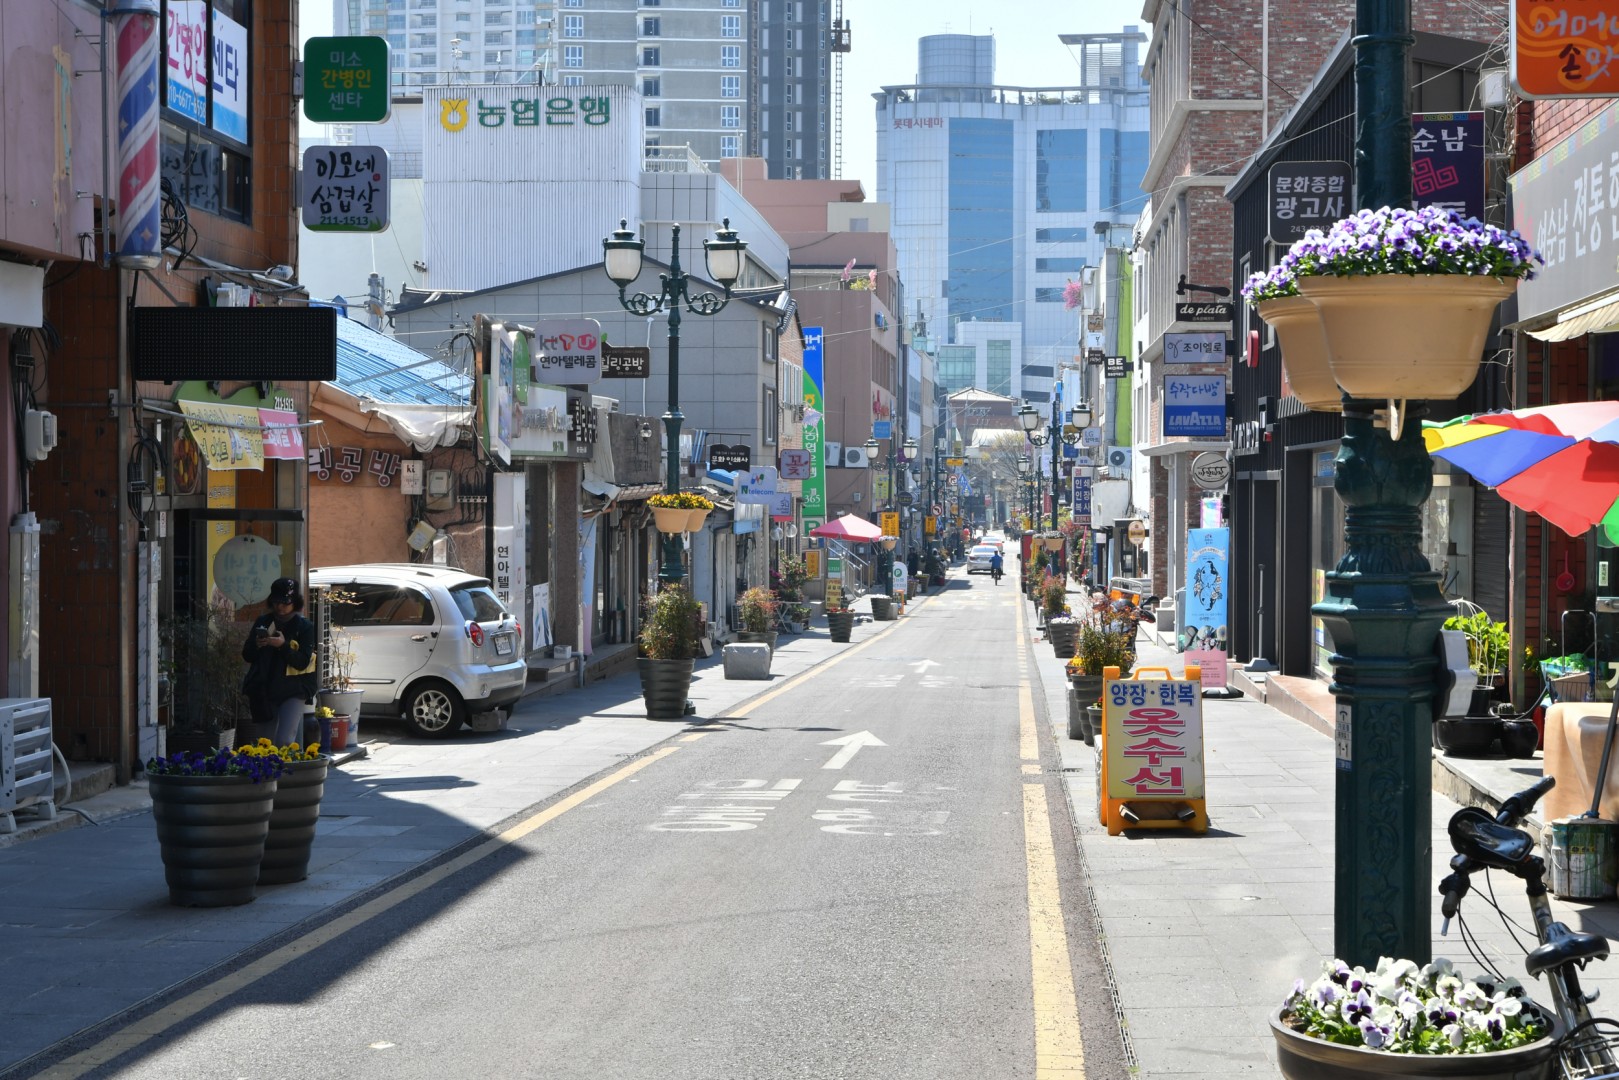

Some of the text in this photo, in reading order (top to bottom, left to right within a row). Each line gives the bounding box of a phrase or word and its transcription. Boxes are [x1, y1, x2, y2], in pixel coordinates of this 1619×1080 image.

[329, 51, 362, 65] 미소
[1558, 43, 1619, 81] 손맛
[320, 69, 372, 89] 간병인
[328, 91, 364, 110] 센타
[477, 96, 611, 128] 농협은행
[893, 117, 945, 129] 롯데시네마
[315, 151, 376, 179] 이모네
[1276, 176, 1346, 193] 문화종합
[311, 182, 380, 214] 삼겹살
[1276, 196, 1346, 220] 광고사
[319, 215, 369, 226] 211-1513
[1536, 198, 1568, 271] 여순남
[1180, 304, 1227, 316] de plata
[540, 335, 558, 350] kt
[1182, 342, 1223, 353] 조이엘로
[539, 356, 597, 369] 연아텔레콤
[1107, 358, 1123, 366] BE
[1169, 381, 1220, 399] 수작다방
[1168, 411, 1222, 426] LAVAZZA
[711, 455, 748, 465] 문화 인쇄사
[785, 455, 806, 476] 꽃
[1075, 479, 1091, 488] 인쇄
[804, 495, 821, 503] 365
[1075, 492, 1091, 500] 인장
[1075, 503, 1091, 512] 복사
[497, 545, 510, 604] 연아텔레
[1111, 684, 1195, 707] 양장·한복
[1122, 707, 1186, 795] 옷수선
